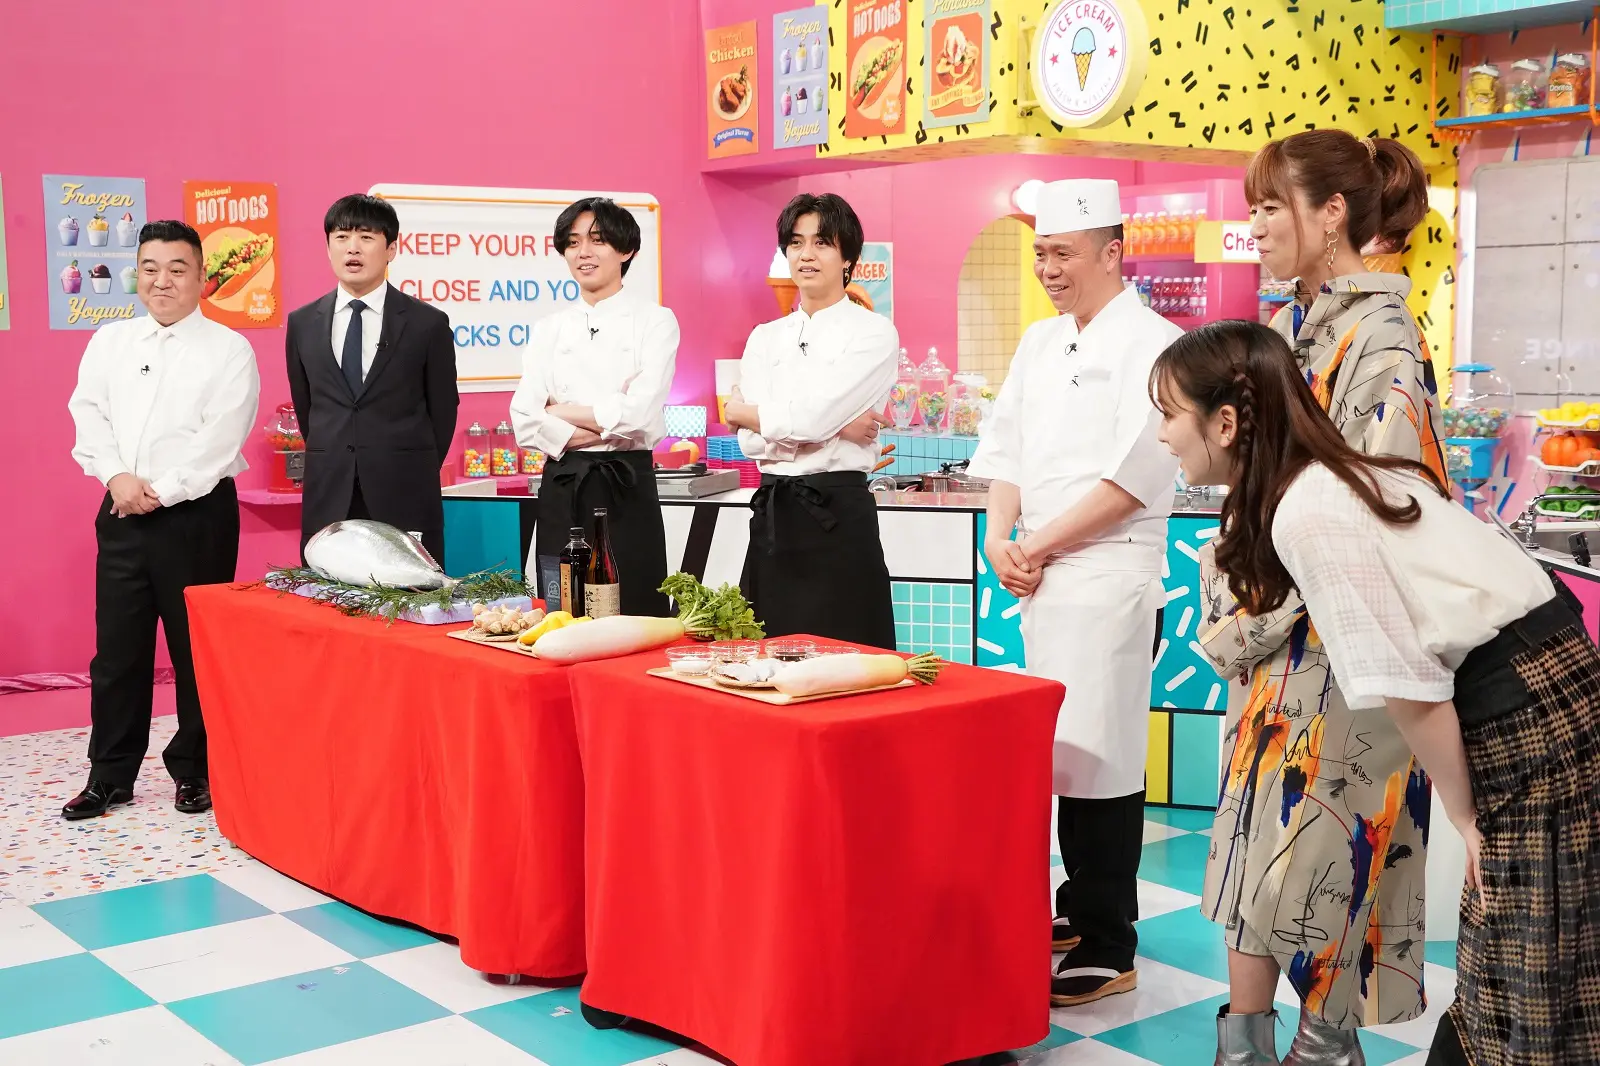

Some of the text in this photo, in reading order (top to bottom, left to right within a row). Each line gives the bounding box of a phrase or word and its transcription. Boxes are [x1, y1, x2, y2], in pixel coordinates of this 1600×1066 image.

[781, 17, 822, 41] Frozen
[853, 0, 901, 38] HOT DOGS
[1054, 4, 1115, 38] ICE CREAM
[709, 45, 754, 63] Chicken
[1549, 84, 1573, 92] Doritos
[784, 118, 821, 143] Yogurt
[60, 183, 135, 212] Frozen
[195, 186, 232, 199] Delicious!
[196, 194, 269, 225] HOT DOGS
[399, 232, 461, 256] KEEP
[469, 233, 536, 257] YOUR
[400, 279, 481, 302] CLOSE
[489, 280, 540, 302] AND
[67, 297, 135, 325] Yogurt
